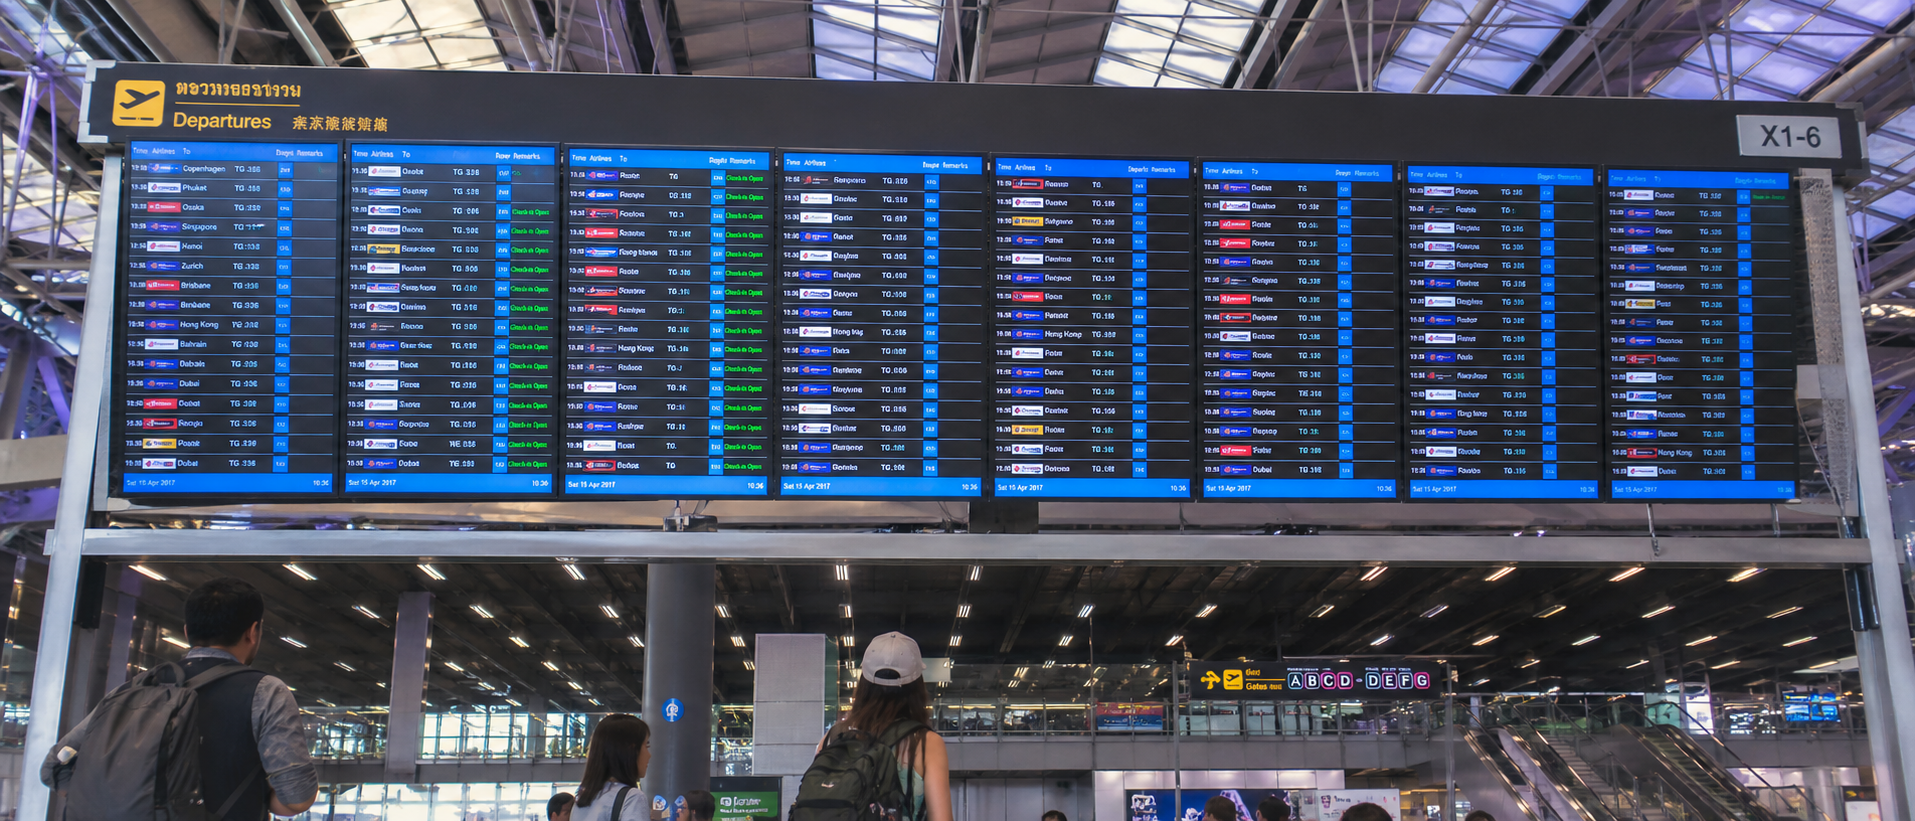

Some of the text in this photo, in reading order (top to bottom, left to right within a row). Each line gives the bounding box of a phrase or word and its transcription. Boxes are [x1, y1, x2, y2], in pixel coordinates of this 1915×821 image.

[174, 112, 271, 131] Departures
[1761, 125, 1821, 148] X1-6
[183, 165, 225, 173] Copenhagen
[200, 321, 219, 329] Kong
[1291, 675, 1427, 686] A B C D D E F G
